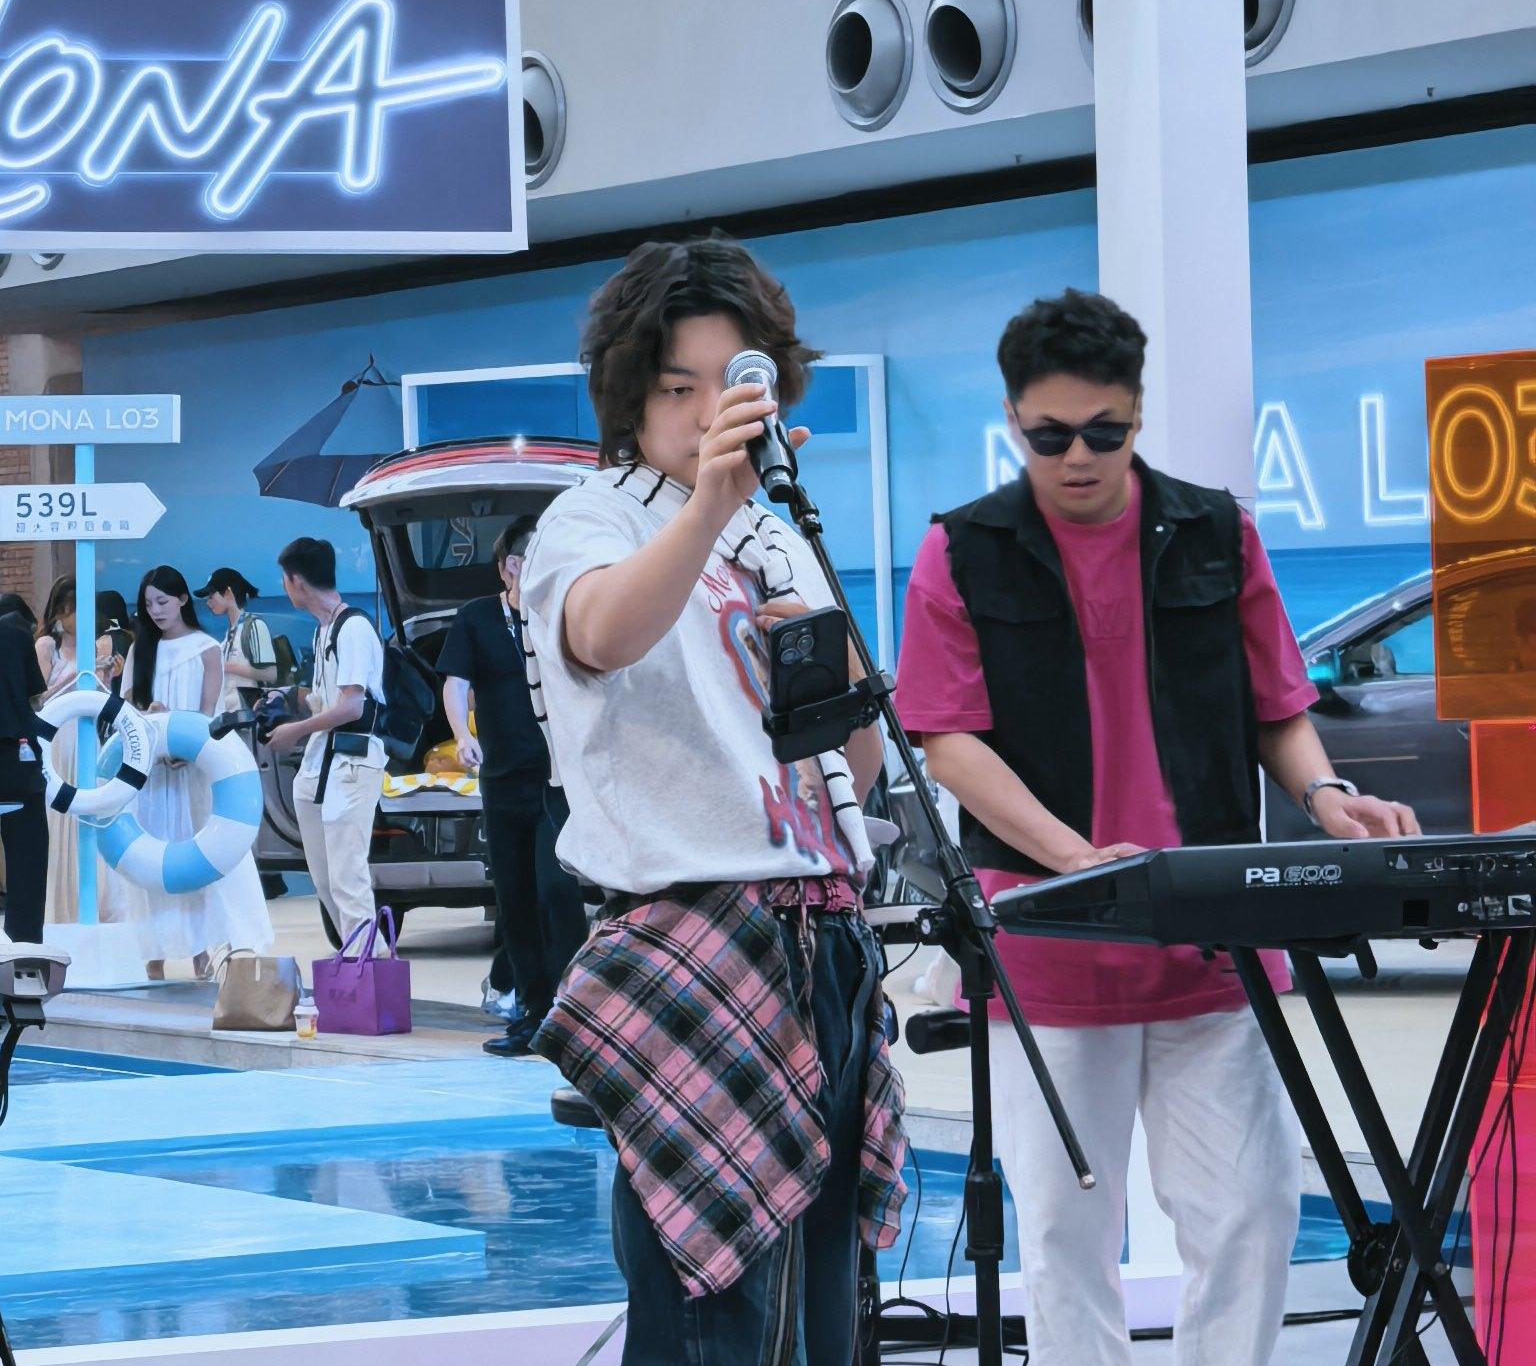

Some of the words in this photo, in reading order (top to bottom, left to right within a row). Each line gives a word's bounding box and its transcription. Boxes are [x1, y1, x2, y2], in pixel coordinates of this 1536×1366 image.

[5, 409, 95, 432] MONA
[16, 492, 98, 518] 539L
[121, 714, 142, 763] WELCOME
